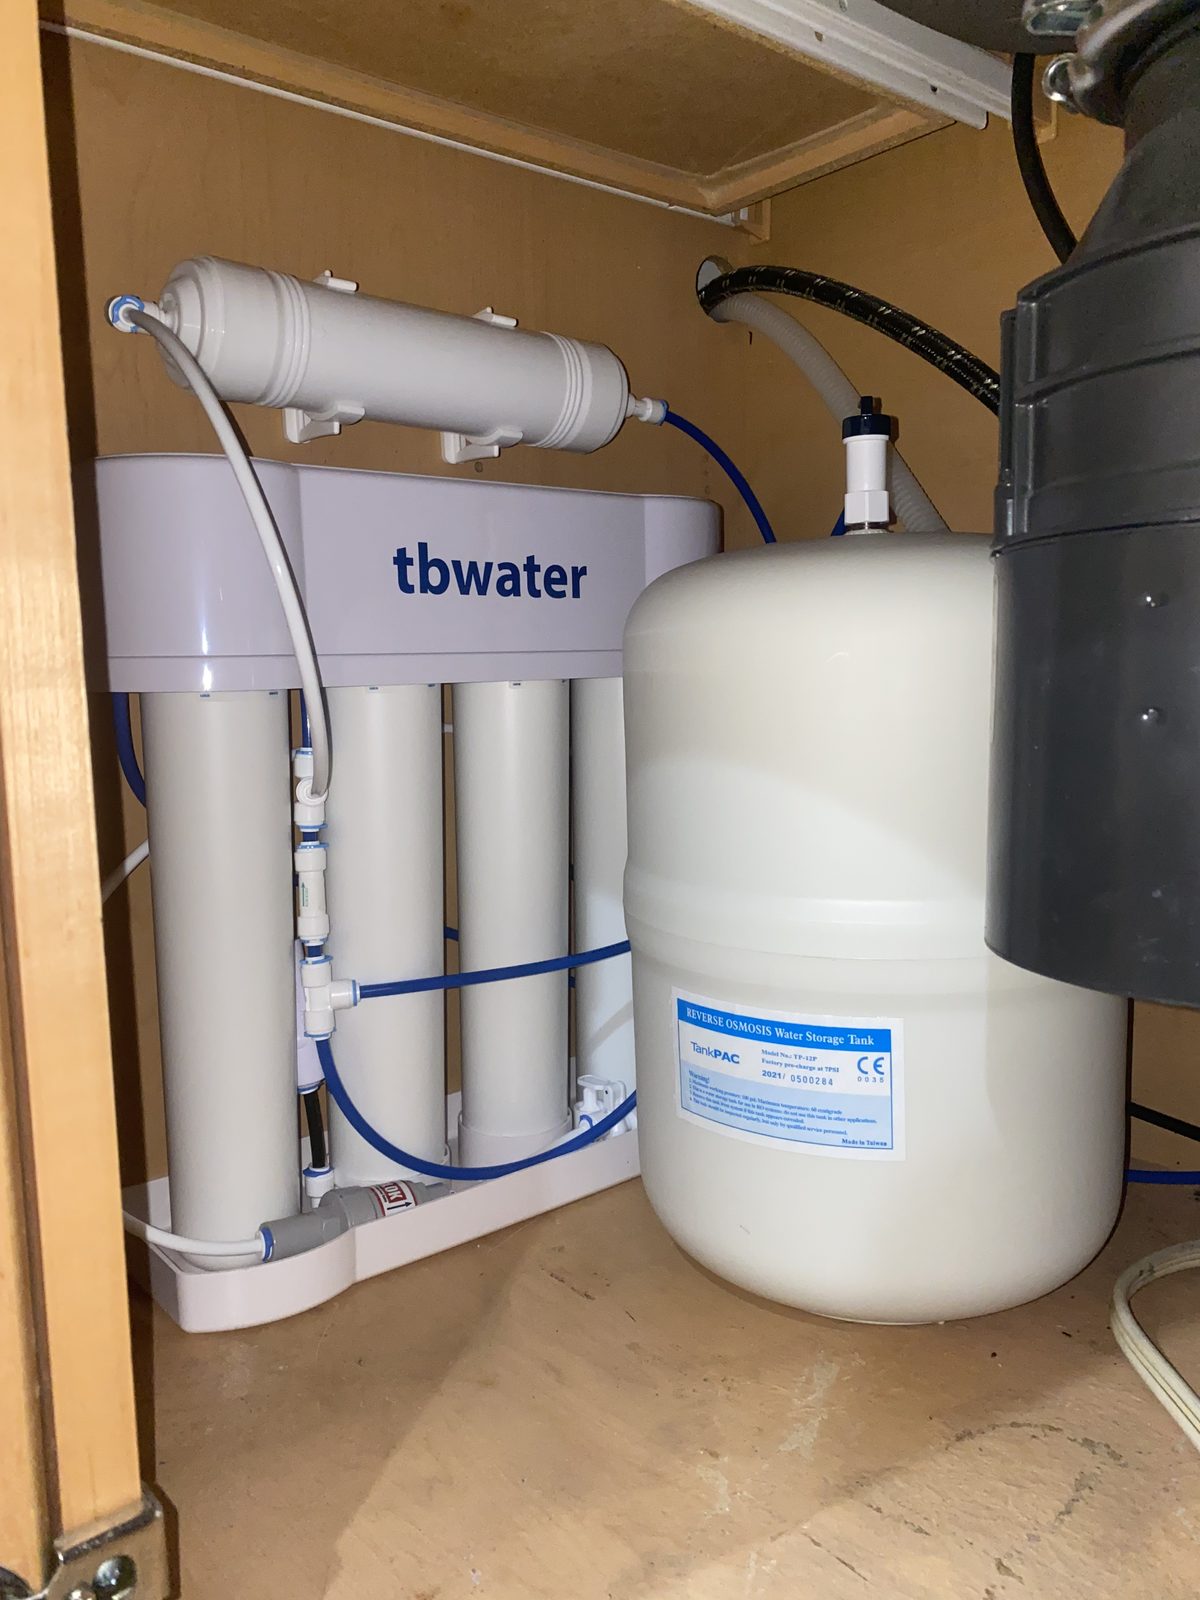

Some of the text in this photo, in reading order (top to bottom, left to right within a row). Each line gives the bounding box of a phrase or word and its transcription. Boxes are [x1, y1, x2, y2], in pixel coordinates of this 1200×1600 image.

[393, 541, 588, 599] tbwater
[686, 1007, 875, 1046] REVERSE OSMOSIS Water Storage Tank
[691, 1041, 740, 1064] TankPAC
[761, 1049, 779, 1057] Model
[761, 1058, 783, 1067] Factory
[784, 1062, 816, 1071] pre-charge
[790, 1074, 833, 1086] 0500284
